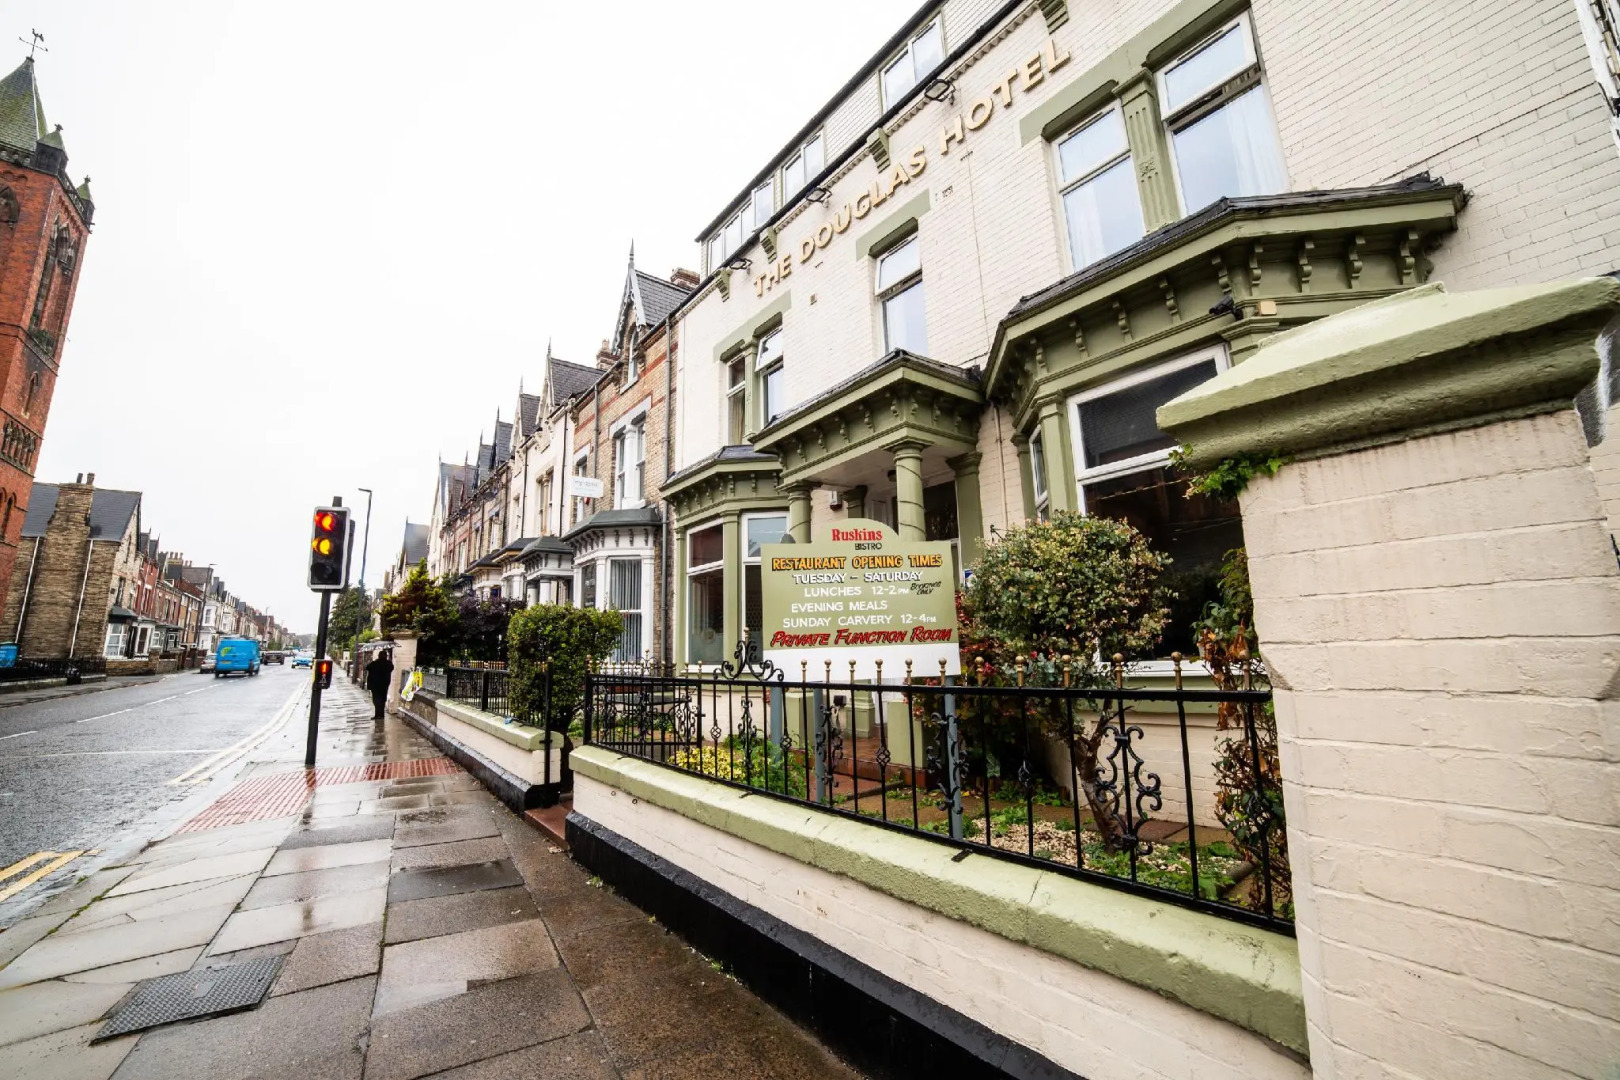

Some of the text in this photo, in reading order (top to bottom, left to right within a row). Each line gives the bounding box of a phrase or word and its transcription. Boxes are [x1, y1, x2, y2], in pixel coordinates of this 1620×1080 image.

[754, 40, 1071, 297] THE DOUGLAS HOTEL
[832, 528, 883, 542] Ruskins
[772, 554, 943, 571] RESTAURANT OPENING TIMES
[792, 572, 847, 584] TUESDAY
[864, 571, 923, 582] SATURDAY
[804, 586, 862, 597] LUNCHES
[791, 600, 888, 613] EVENING MEALS
[783, 617, 831, 628] SUNDAY
[838, 615, 893, 626] CARVERY
[770, 626, 953, 647] PRIVATE FUNCTION ROOM
